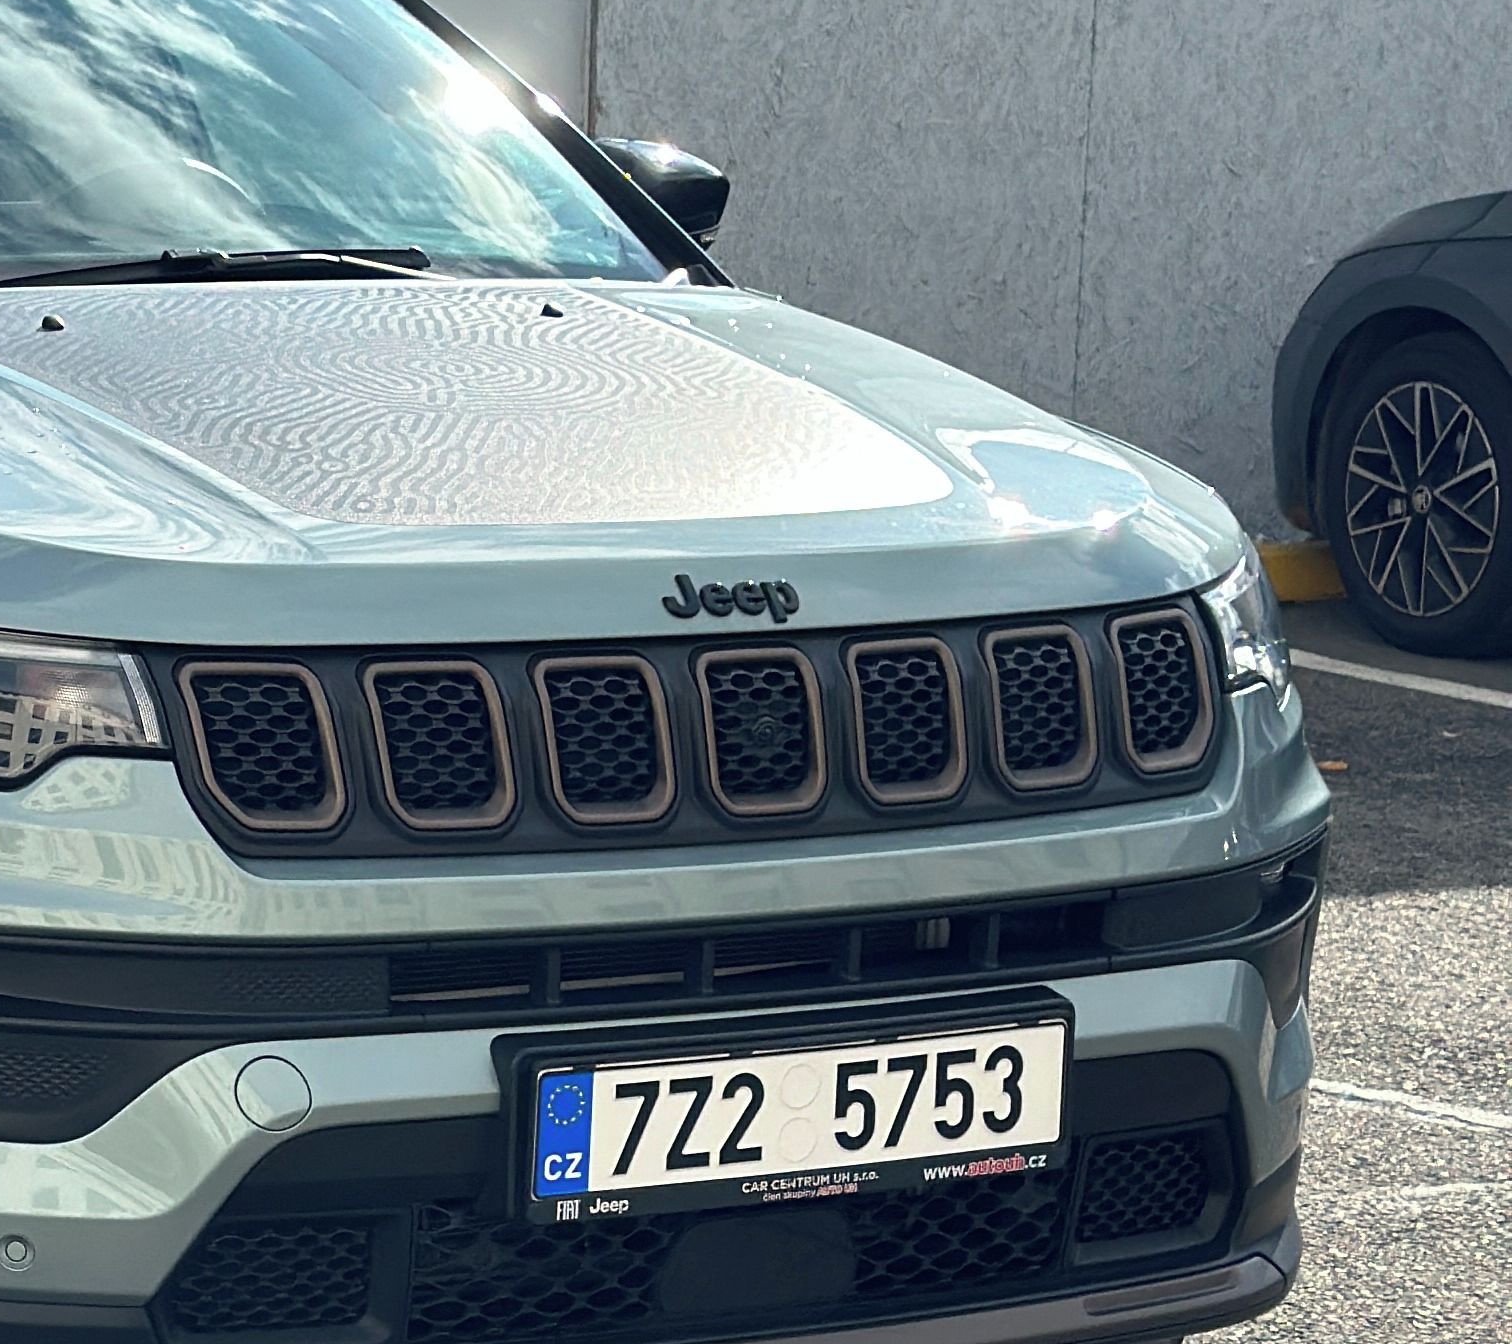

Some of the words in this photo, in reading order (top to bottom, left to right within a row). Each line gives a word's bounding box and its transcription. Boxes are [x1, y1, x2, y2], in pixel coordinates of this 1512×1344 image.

[662, 574, 799, 623] Jeep
[612, 1072, 765, 1176] 7Z2
[834, 1045, 1024, 1151] 5753
[544, 1152, 583, 1181] CZ
[923, 1153, 1047, 1181] www.autouh.cz
[742, 1180, 768, 1194] CAR
[770, 1174, 830, 1191] CENTRUM
[833, 1172, 850, 1184] UH
[853, 1171, 880, 1181] s.r.o.
[556, 1199, 581, 1221] FIAT
[589, 1197, 629, 1214] Jeep
